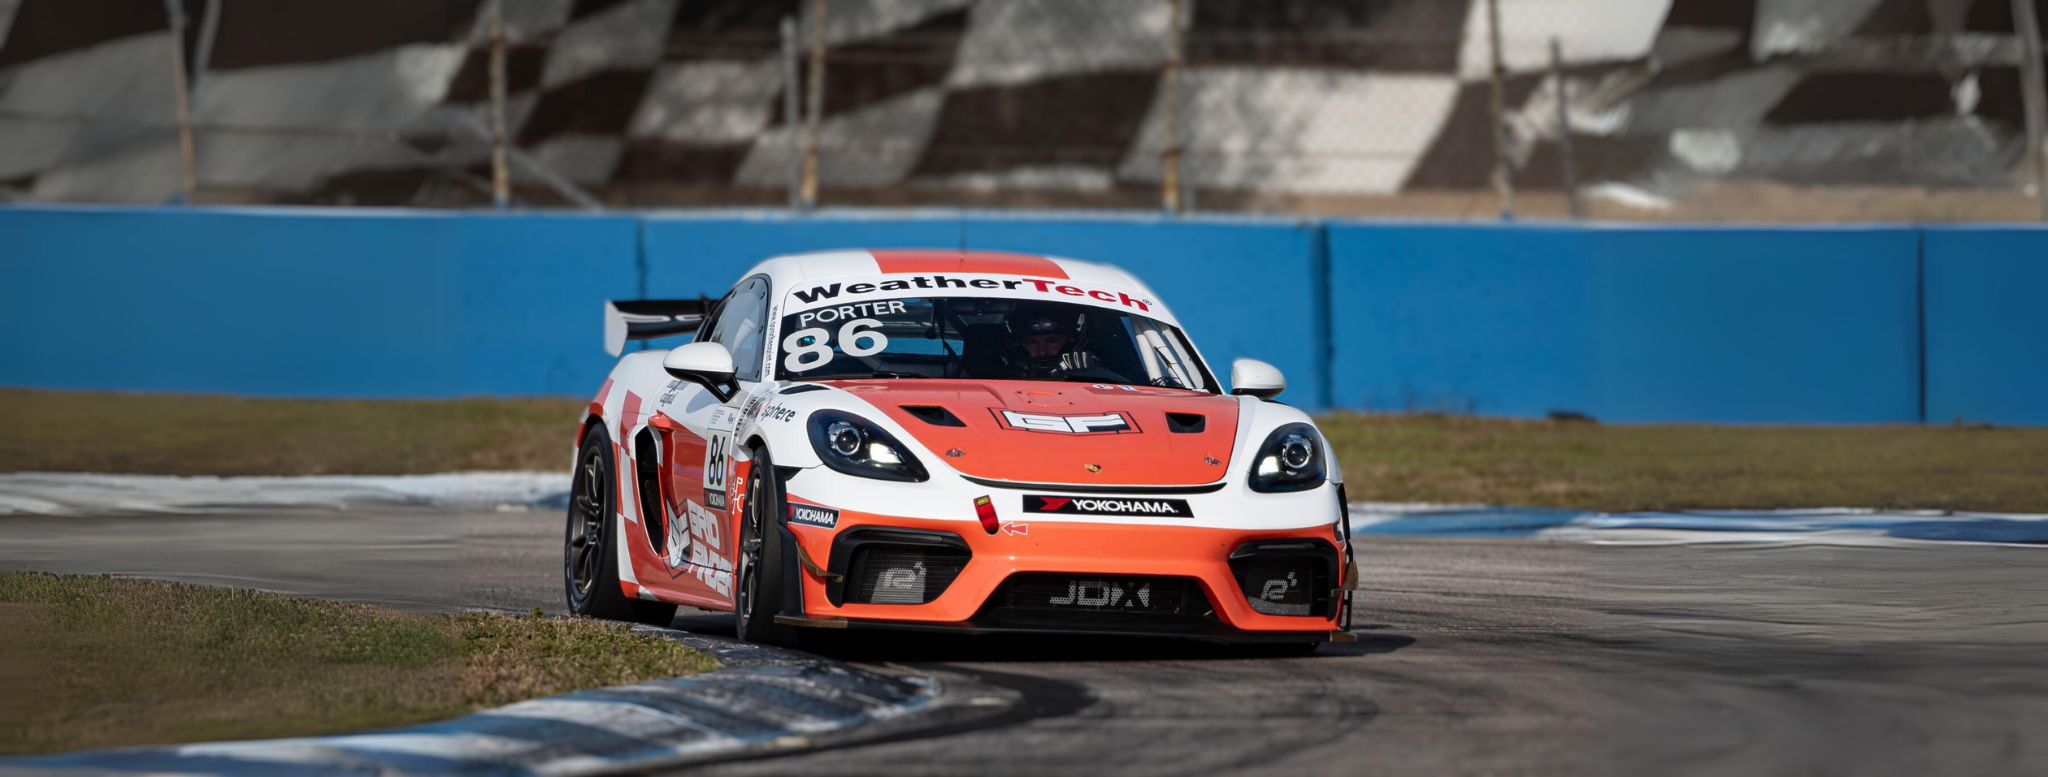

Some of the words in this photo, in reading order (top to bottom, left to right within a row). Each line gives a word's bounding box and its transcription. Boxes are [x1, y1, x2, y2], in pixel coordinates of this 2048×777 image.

[800, 300, 907, 327] PORTER
[782, 317, 889, 373] 86
[761, 402, 796, 422] sphere
[708, 434, 726, 487] 86
[795, 507, 834, 525] YOKOHAMA
[1072, 498, 1179, 514] YOKOHAMA
[687, 498, 720, 551] GRID
[1050, 580, 1150, 608] JDX
